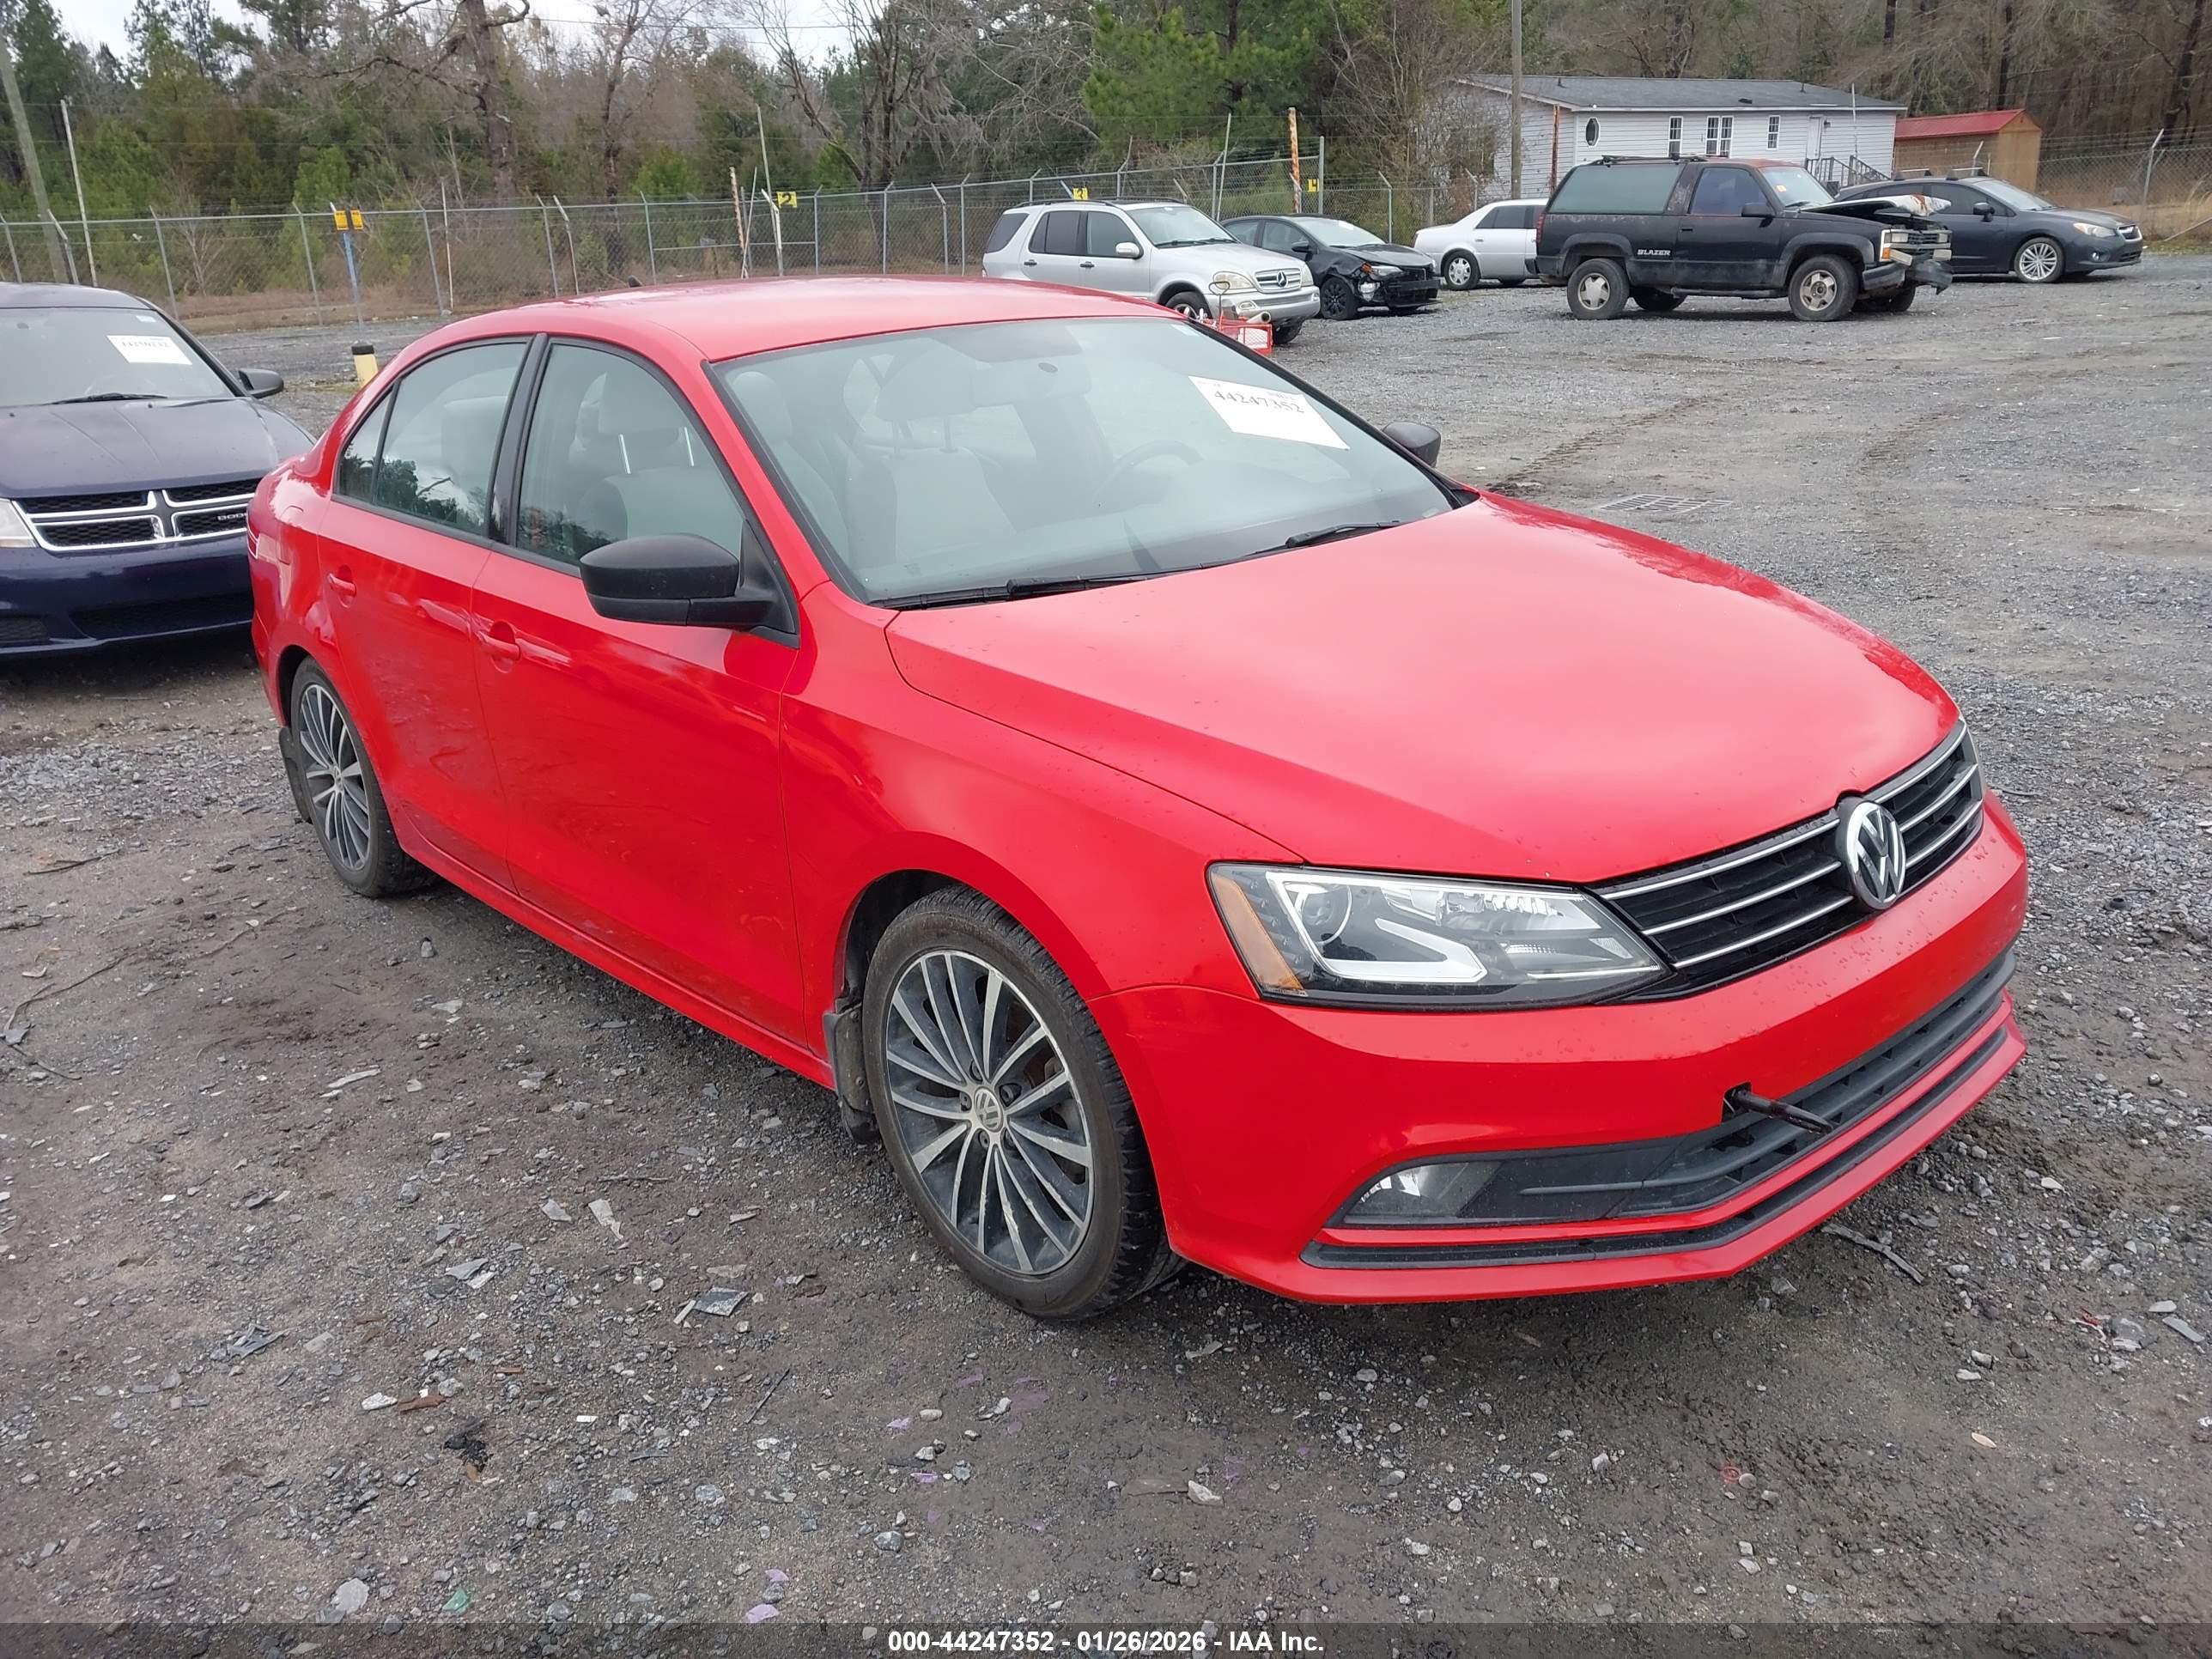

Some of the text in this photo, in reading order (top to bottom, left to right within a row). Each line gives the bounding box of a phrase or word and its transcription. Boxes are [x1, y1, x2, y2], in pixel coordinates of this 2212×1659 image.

[1311, 178, 1318, 192] 4
[781, 191, 793, 207] 2
[1214, 391, 1304, 413] 44247352
